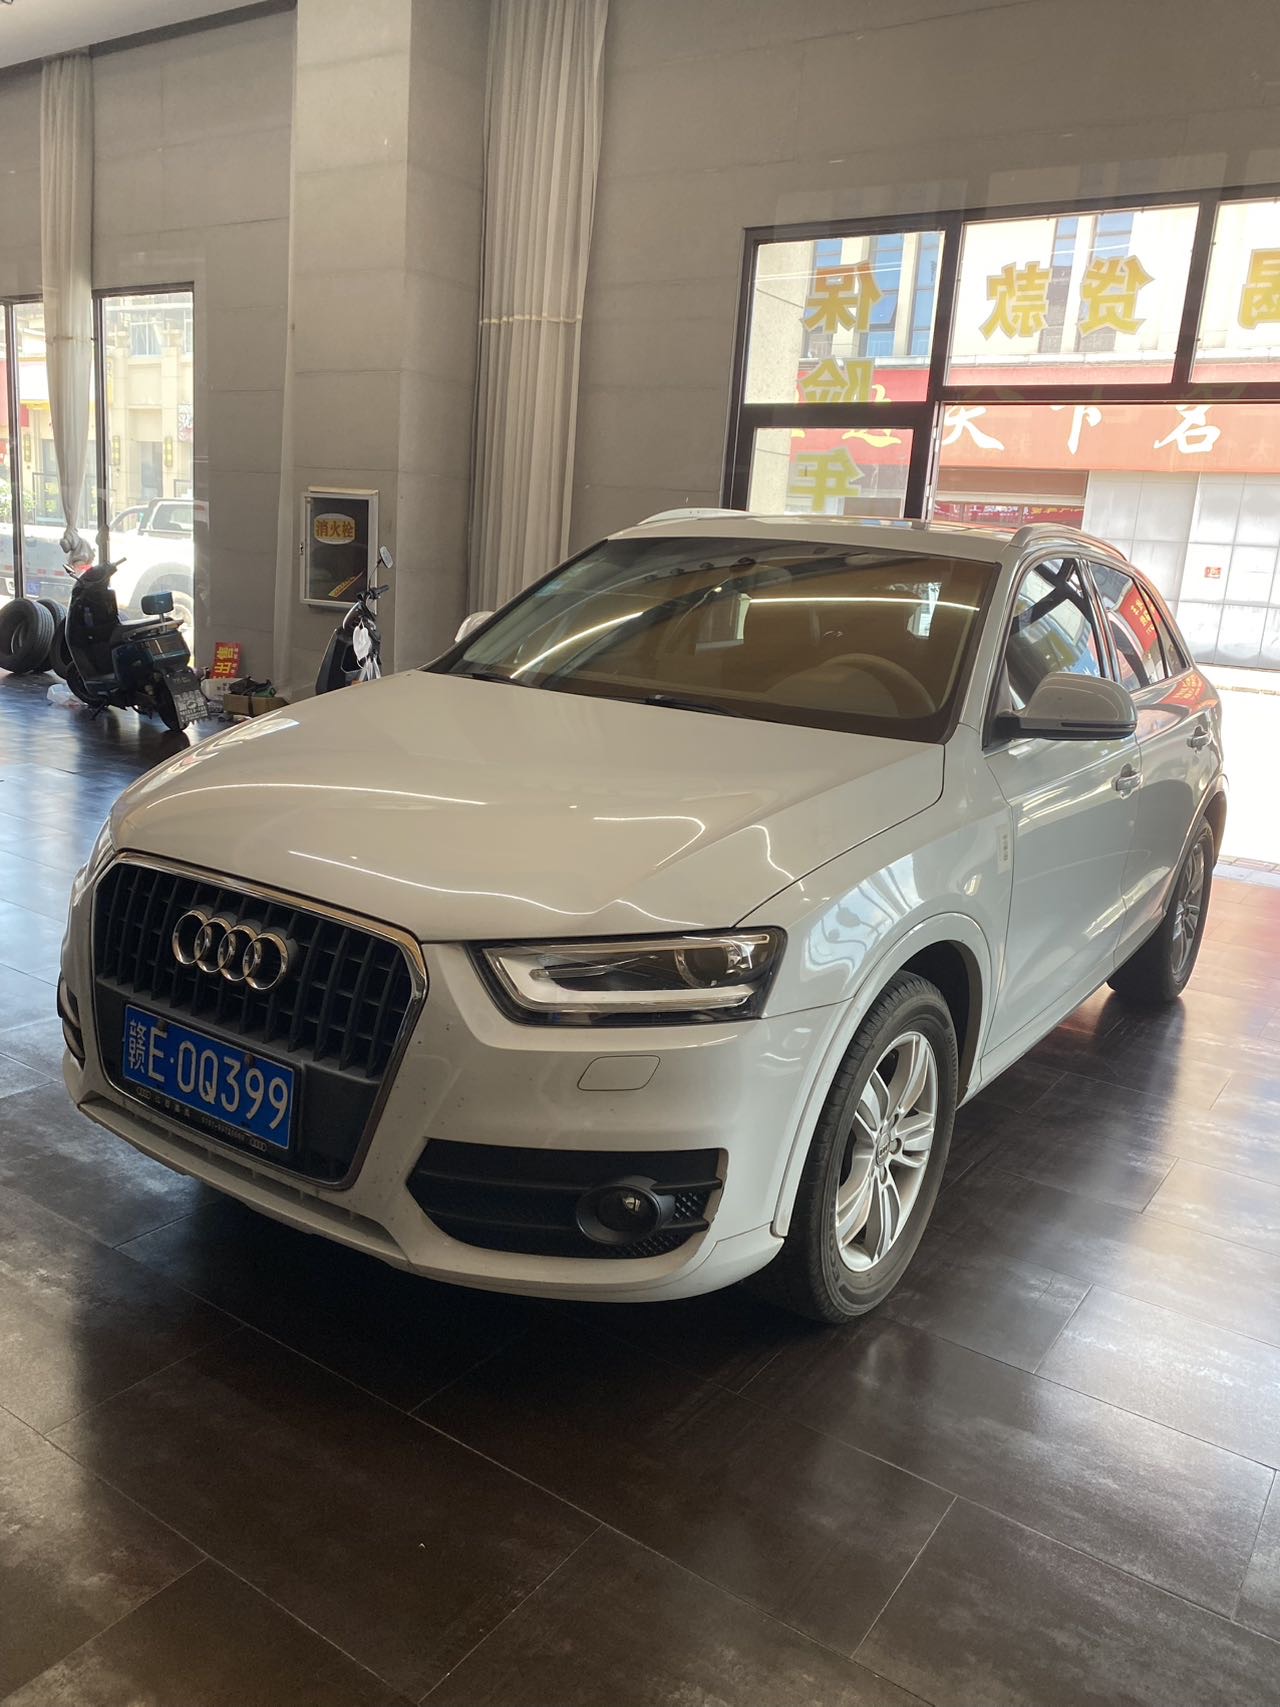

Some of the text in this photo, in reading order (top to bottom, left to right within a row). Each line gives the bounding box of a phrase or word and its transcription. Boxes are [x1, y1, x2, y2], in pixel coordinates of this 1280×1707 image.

[316, 519, 354, 538] 消火栓
[212, 646, 234, 679] 出售
